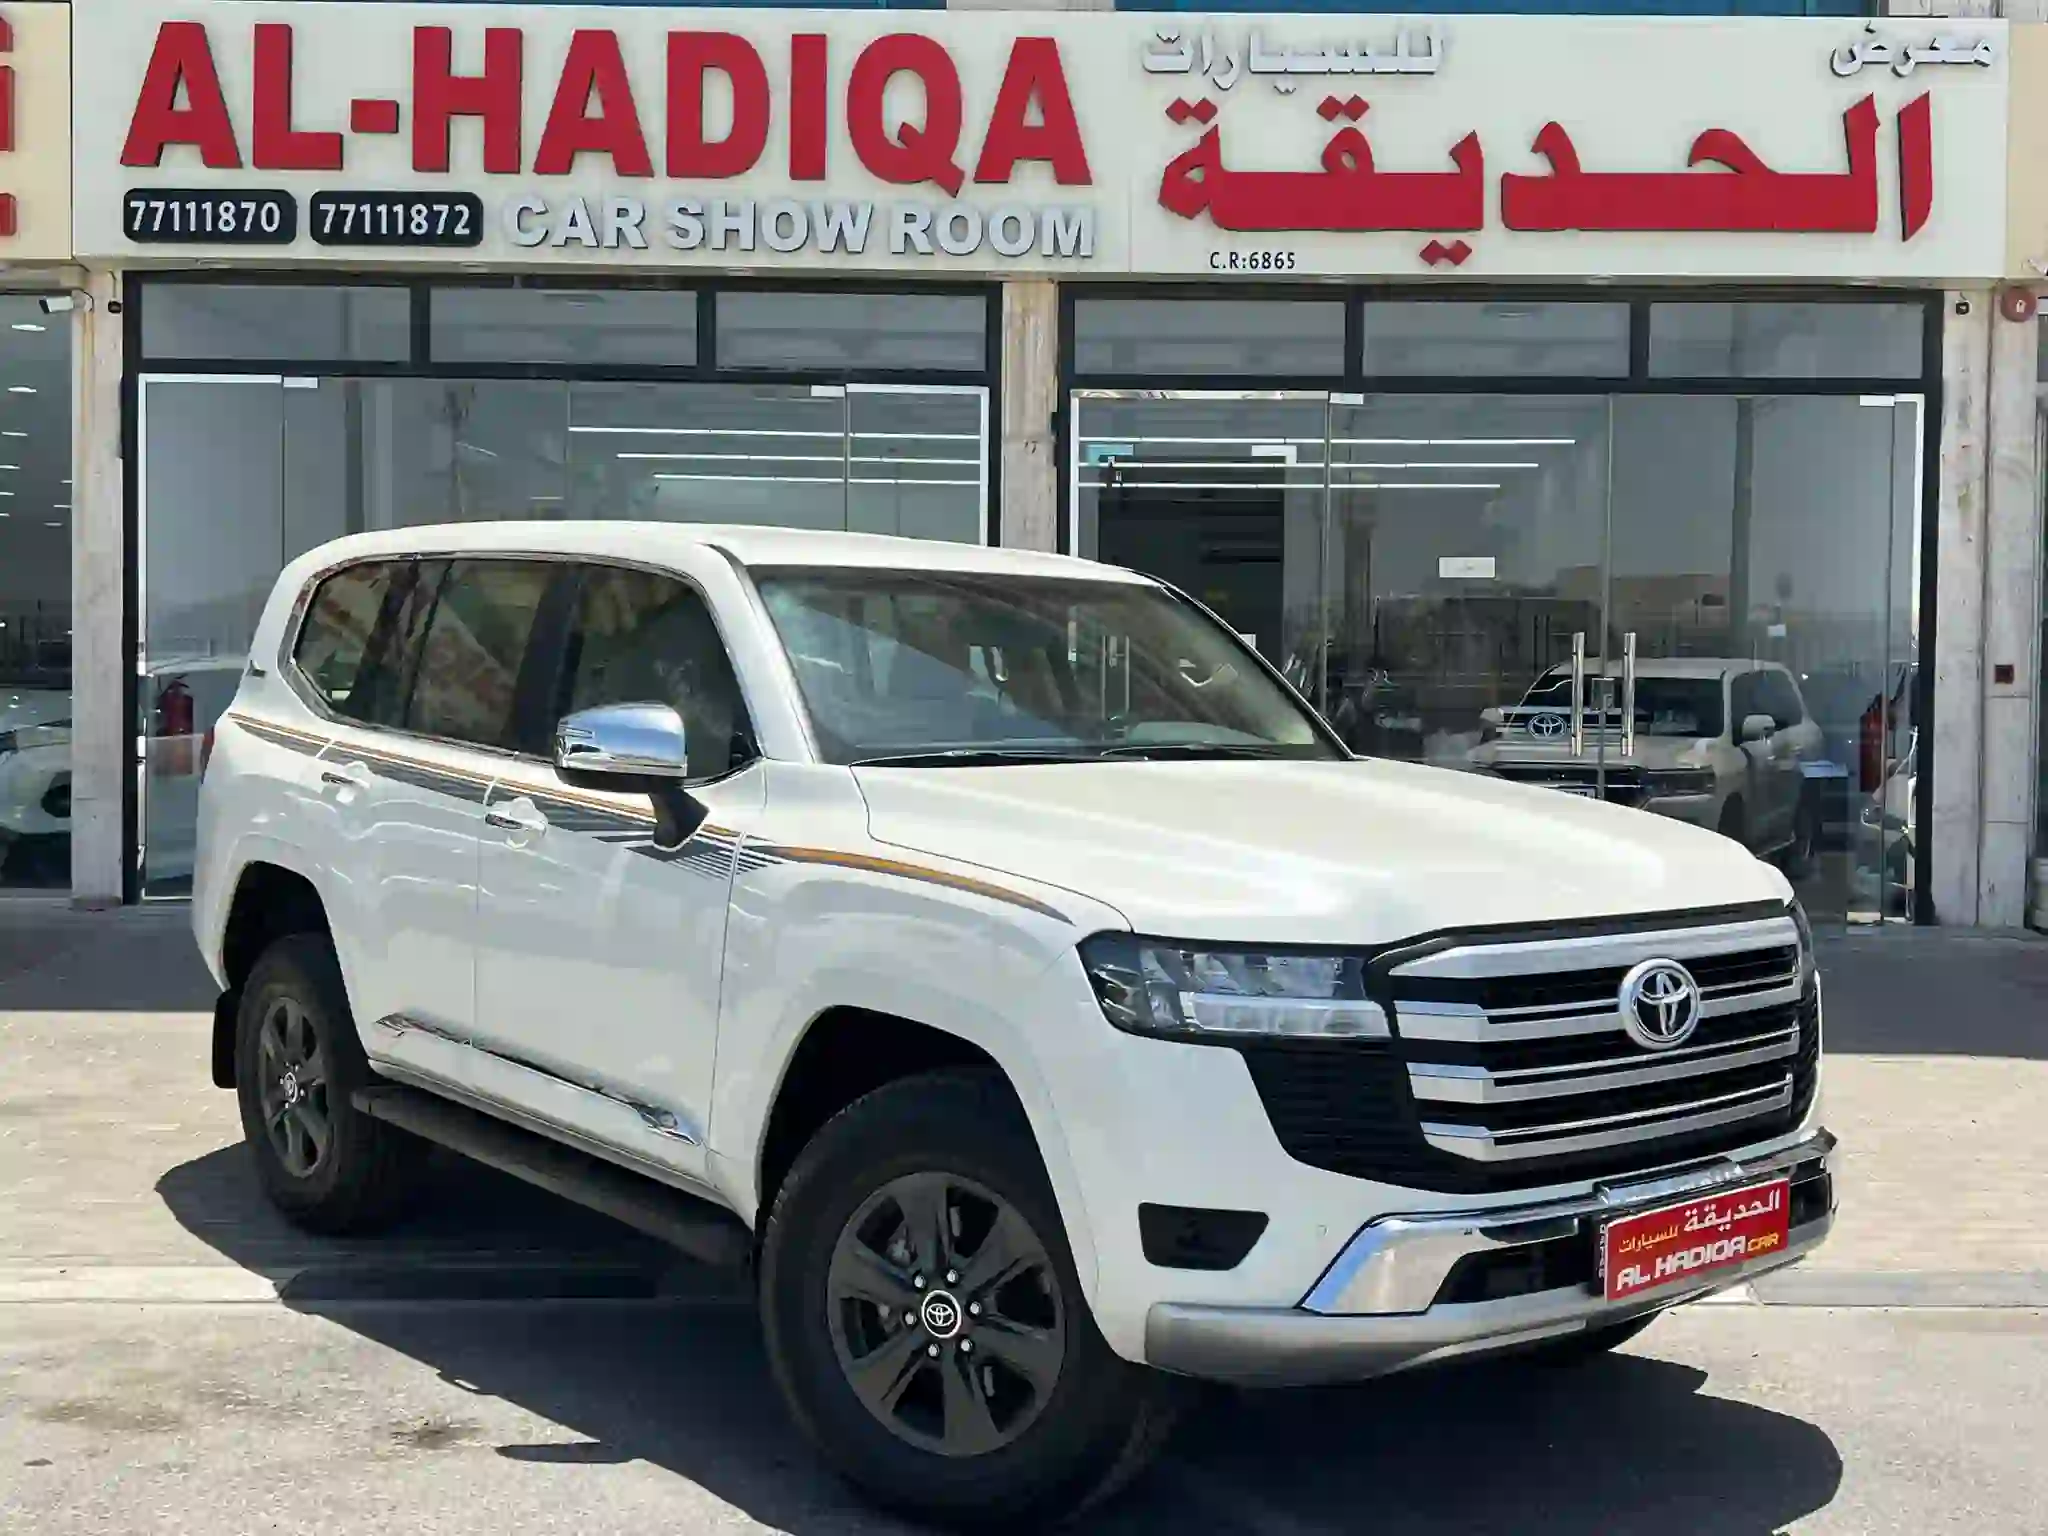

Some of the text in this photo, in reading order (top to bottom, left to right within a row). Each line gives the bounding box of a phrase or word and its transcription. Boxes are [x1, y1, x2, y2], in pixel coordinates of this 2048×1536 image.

[1142, 26, 1445, 94] للسيارات
[1829, 20, 1992, 77] معرض
[120, 22, 1092, 198] AL-HADIQA
[1158, 90, 1932, 266] الحديقة
[129, 200, 281, 233] 77111870
[319, 202, 471, 235] 77111872
[512, 197, 1094, 257] CAR SHOW ROOM
[1210, 251, 1296, 269] C.R:6865
[1618, 1188, 1780, 1253] الحديقة للسيارات
[1616, 1265, 1651, 1291] AL
[1747, 1231, 1779, 1252] CAR
